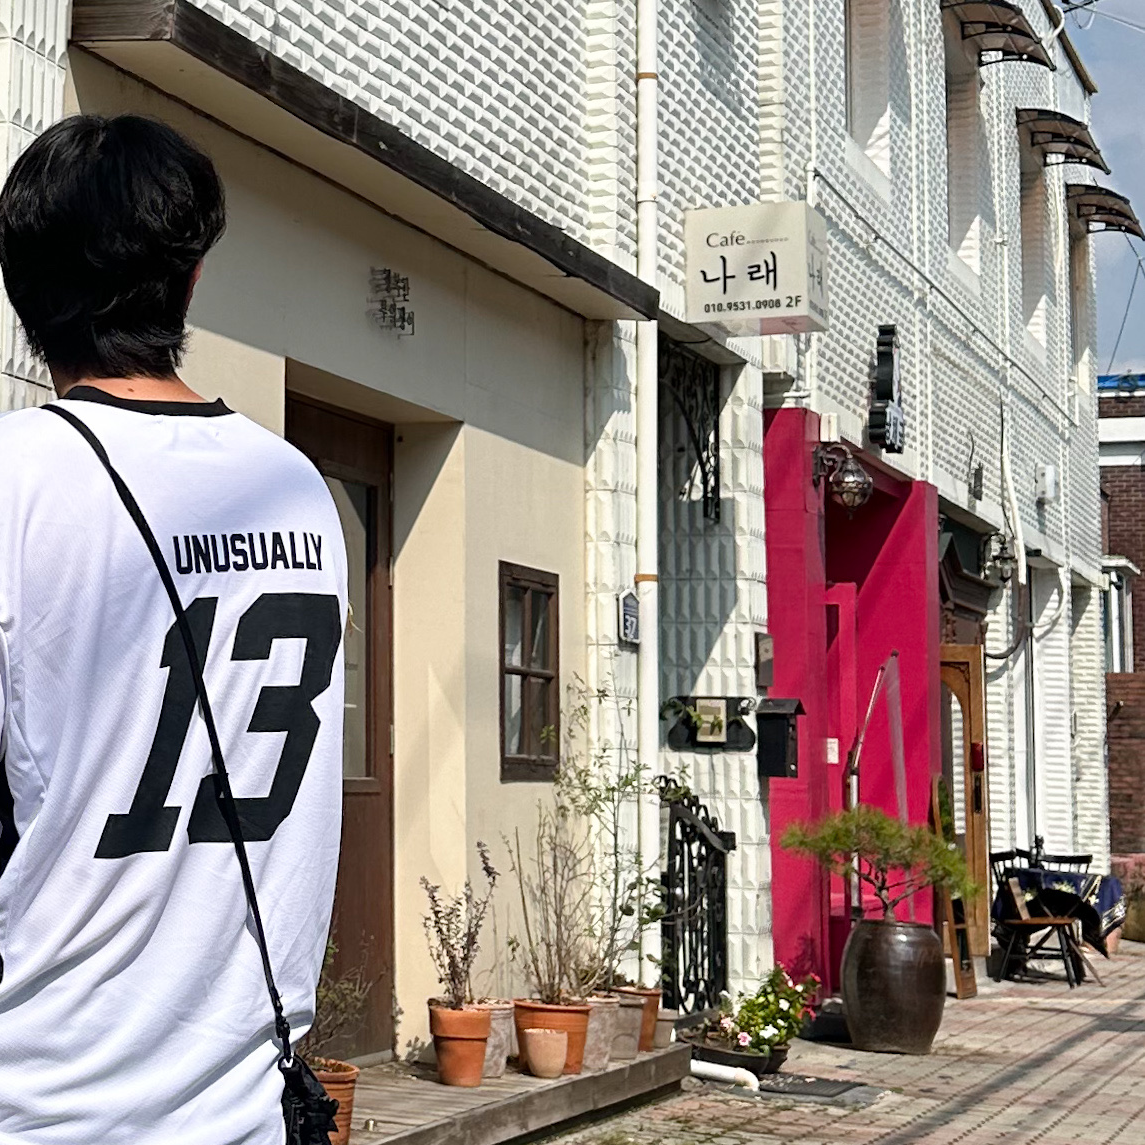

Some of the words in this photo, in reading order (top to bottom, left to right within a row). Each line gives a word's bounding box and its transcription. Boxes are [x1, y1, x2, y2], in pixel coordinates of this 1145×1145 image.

[785, 295, 802, 308] 2F
[172, 531, 323, 575] UNUSUALLY
[625, 614, 636, 636] 37
[93, 592, 342, 858] 13
